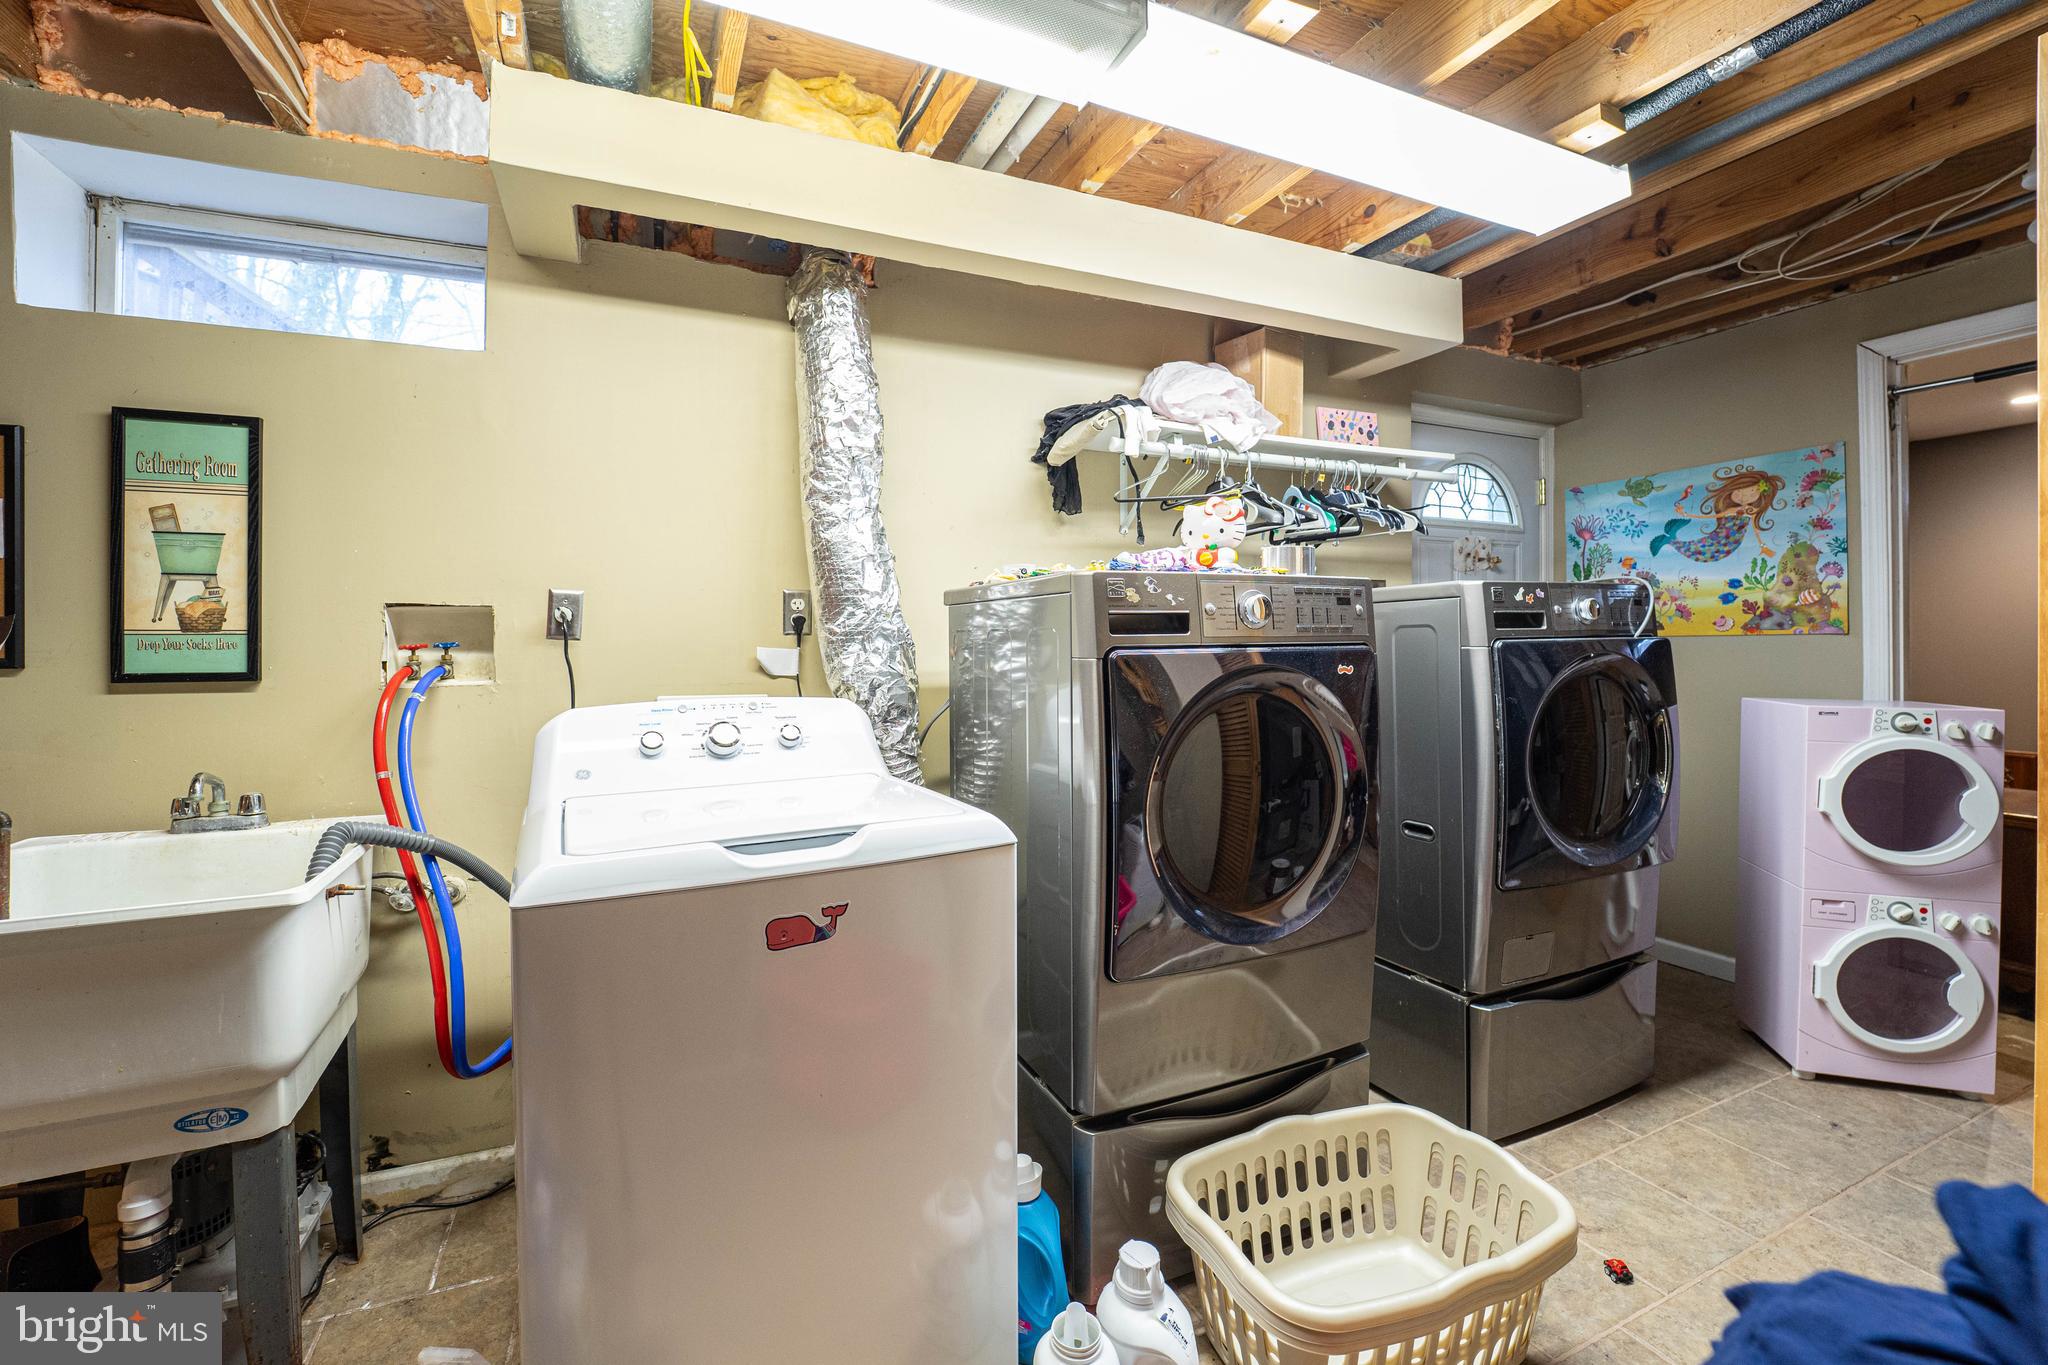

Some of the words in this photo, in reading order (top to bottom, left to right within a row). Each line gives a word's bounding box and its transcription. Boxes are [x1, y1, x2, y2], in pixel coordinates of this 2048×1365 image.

[135, 450, 200, 481] Gathering
[204, 455, 238, 477] Room
[137, 638, 160, 653] Drop
[162, 638, 184, 650] Your
[186, 637, 212, 650] Socks
[215, 638, 238, 650] Here
